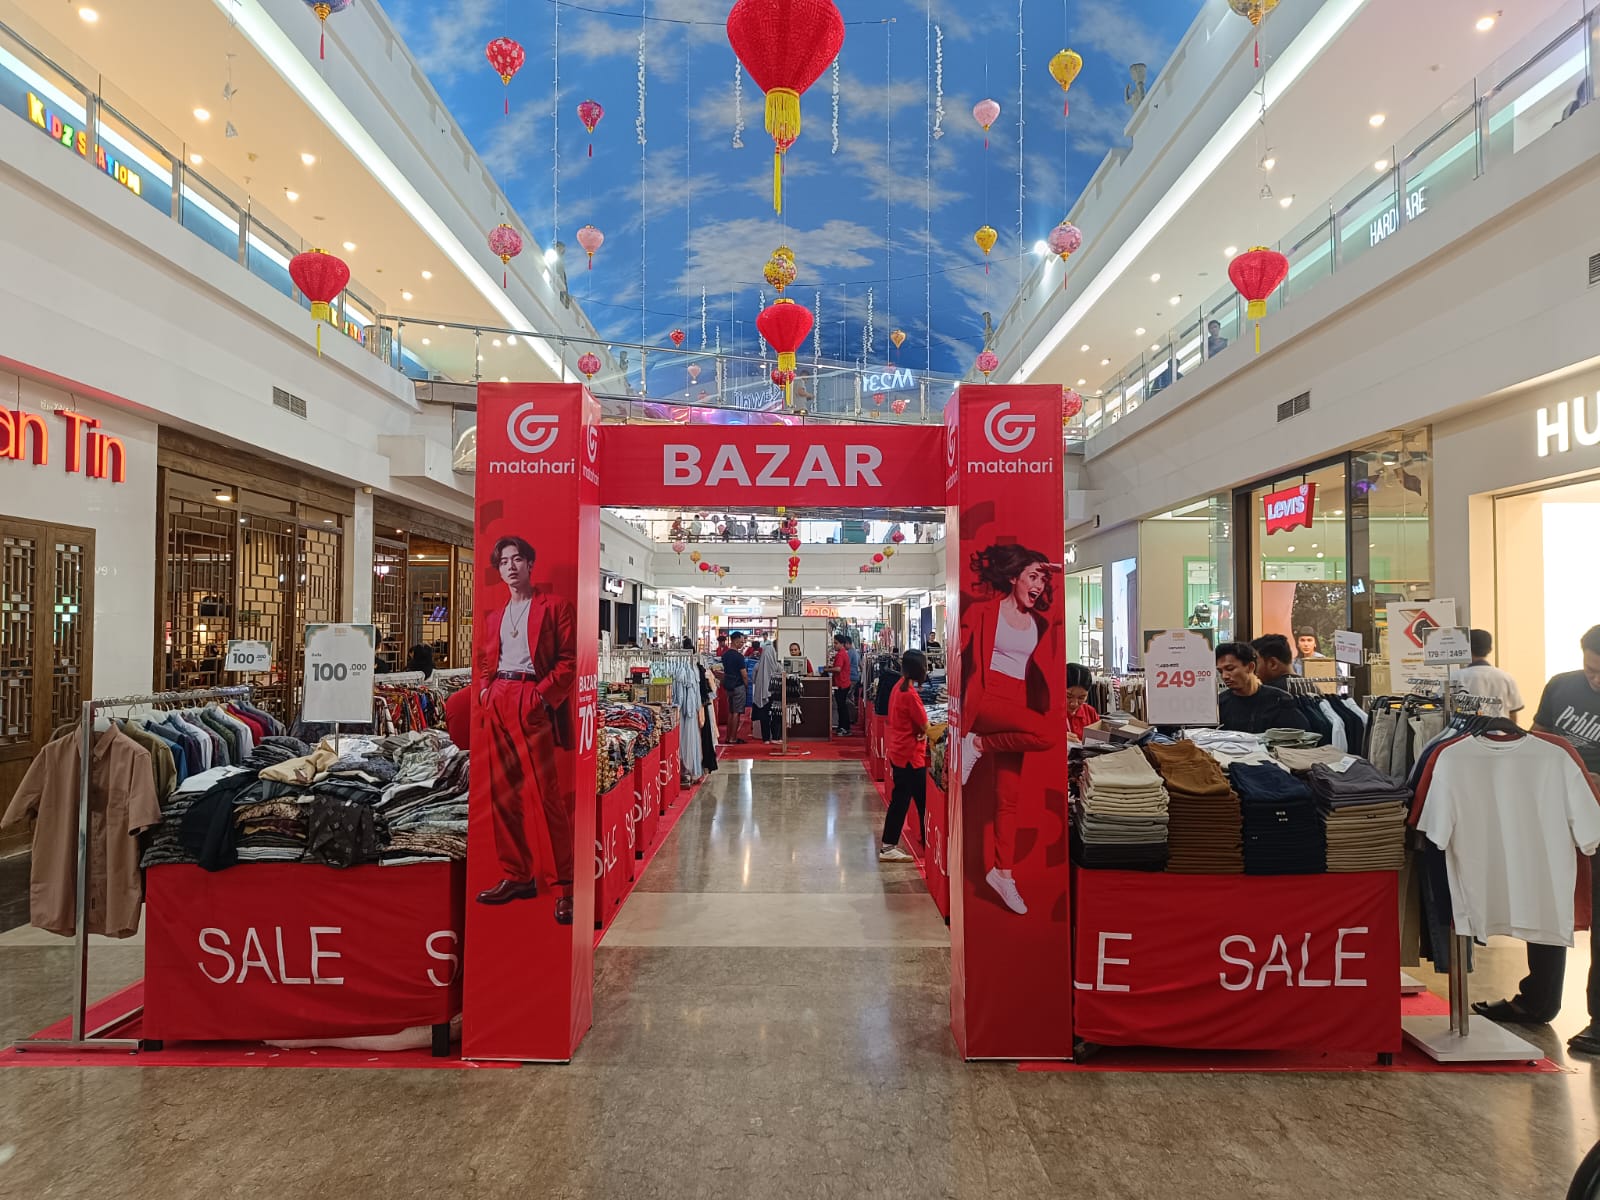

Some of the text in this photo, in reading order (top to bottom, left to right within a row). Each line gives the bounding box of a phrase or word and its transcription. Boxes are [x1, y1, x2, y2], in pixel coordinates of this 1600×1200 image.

[27, 91, 142, 197] KIDZ SATION
[1370, 186, 1428, 248] HARDARE
[1537, 389, 1600, 457] HU
[54, 409, 126, 483] Tin
[489, 458, 576, 474] matahari
[663, 444, 883, 487] BAZAR
[967, 457, 1053, 473] matahari
[233, 653, 255, 665] 100
[312, 662, 348, 682] 100
[1156, 669, 1196, 688] 249
[579, 673, 597, 693] BAZAR
[198, 926, 344, 985] SALE
[1219, 926, 1369, 992] SALE
